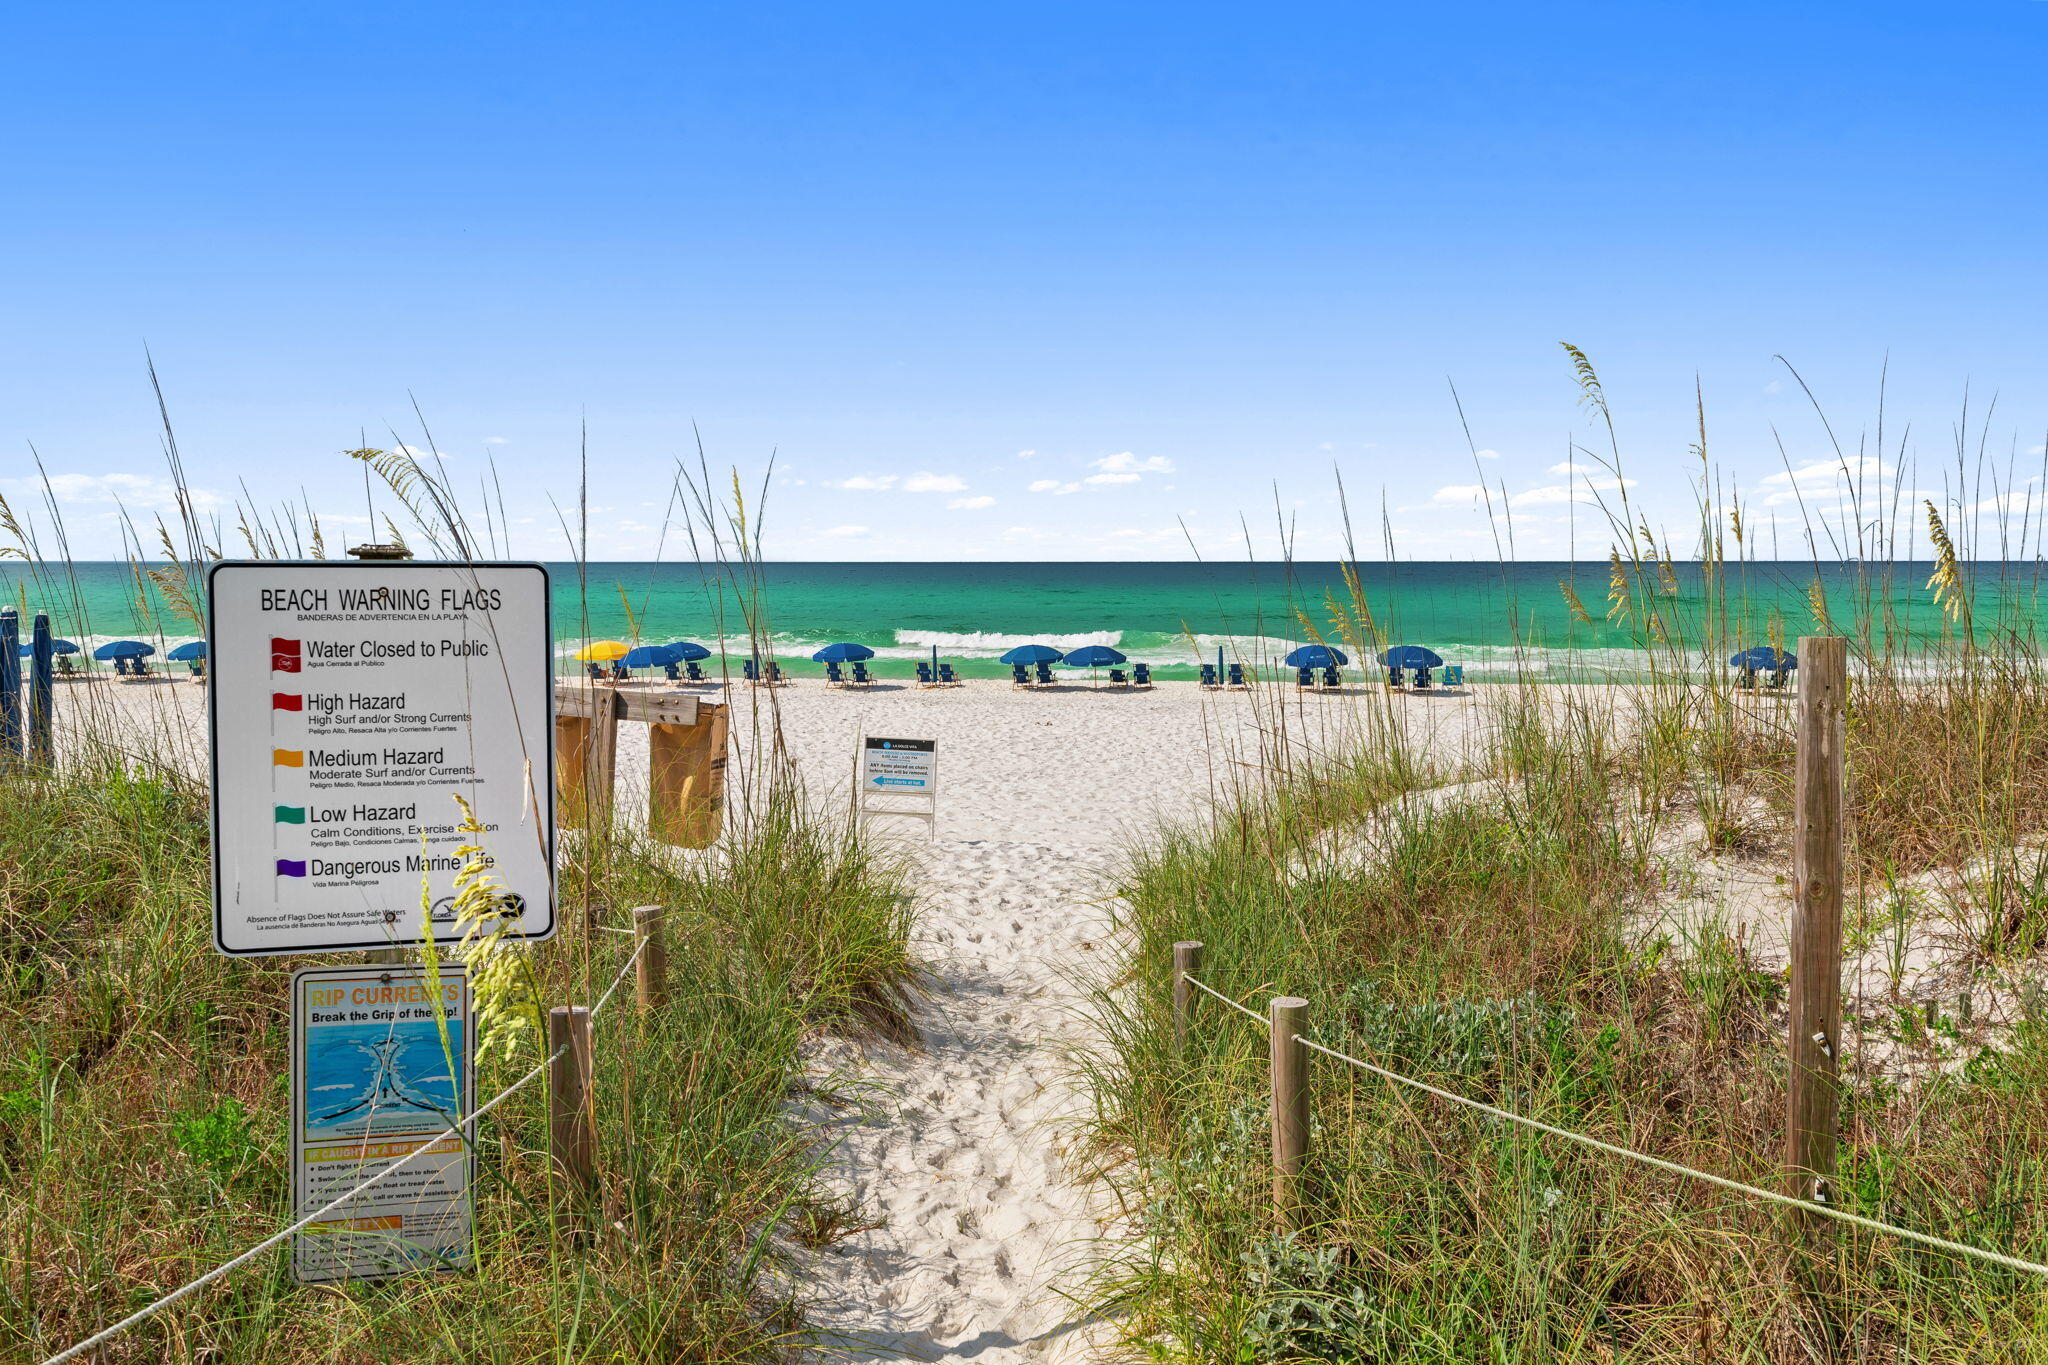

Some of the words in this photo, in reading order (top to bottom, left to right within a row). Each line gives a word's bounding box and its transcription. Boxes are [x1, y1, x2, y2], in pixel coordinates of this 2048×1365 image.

[261, 589, 327, 611] BEACH
[339, 589, 430, 610] WARNING
[442, 589, 501, 610] FLAGS
[307, 641, 355, 658] Water
[360, 641, 415, 657] Closed
[420, 642, 435, 657] to
[441, 640, 488, 656] Public
[308, 693, 343, 714] High
[350, 693, 405, 710] Hazard
[308, 715, 331, 727] High
[335, 714, 356, 724] Surf
[359, 714, 390, 724] and/or
[394, 713, 426, 725] Strong
[429, 713, 472, 722] Currents
[309, 749, 376, 767] Medium
[384, 748, 444, 765] Hazard
[309, 768, 361, 780] Moderate
[365, 768, 388, 778] Surf
[391, 767, 426, 777] and/or
[429, 766, 475, 775] Currents
[310, 806, 346, 822] Low
[353, 803, 416, 821] Hazard
[311, 828, 340, 838] Calm
[343, 826, 404, 837] Conditions,
[408, 824, 454, 834] Exercise
[312, 859, 400, 879] Dangerous
[406, 854, 460, 872] Marine
[247, 915, 277, 923] Absence
[312, 989, 345, 1007] RIP
[312, 1012, 346, 1022] Break
[350, 1011, 368, 1021] the
[372, 1010, 395, 1022] Grip
[399, 1009, 411, 1018] of
[414, 1008, 432, 1017] the
[438, 1007, 457, 1018] ip!
